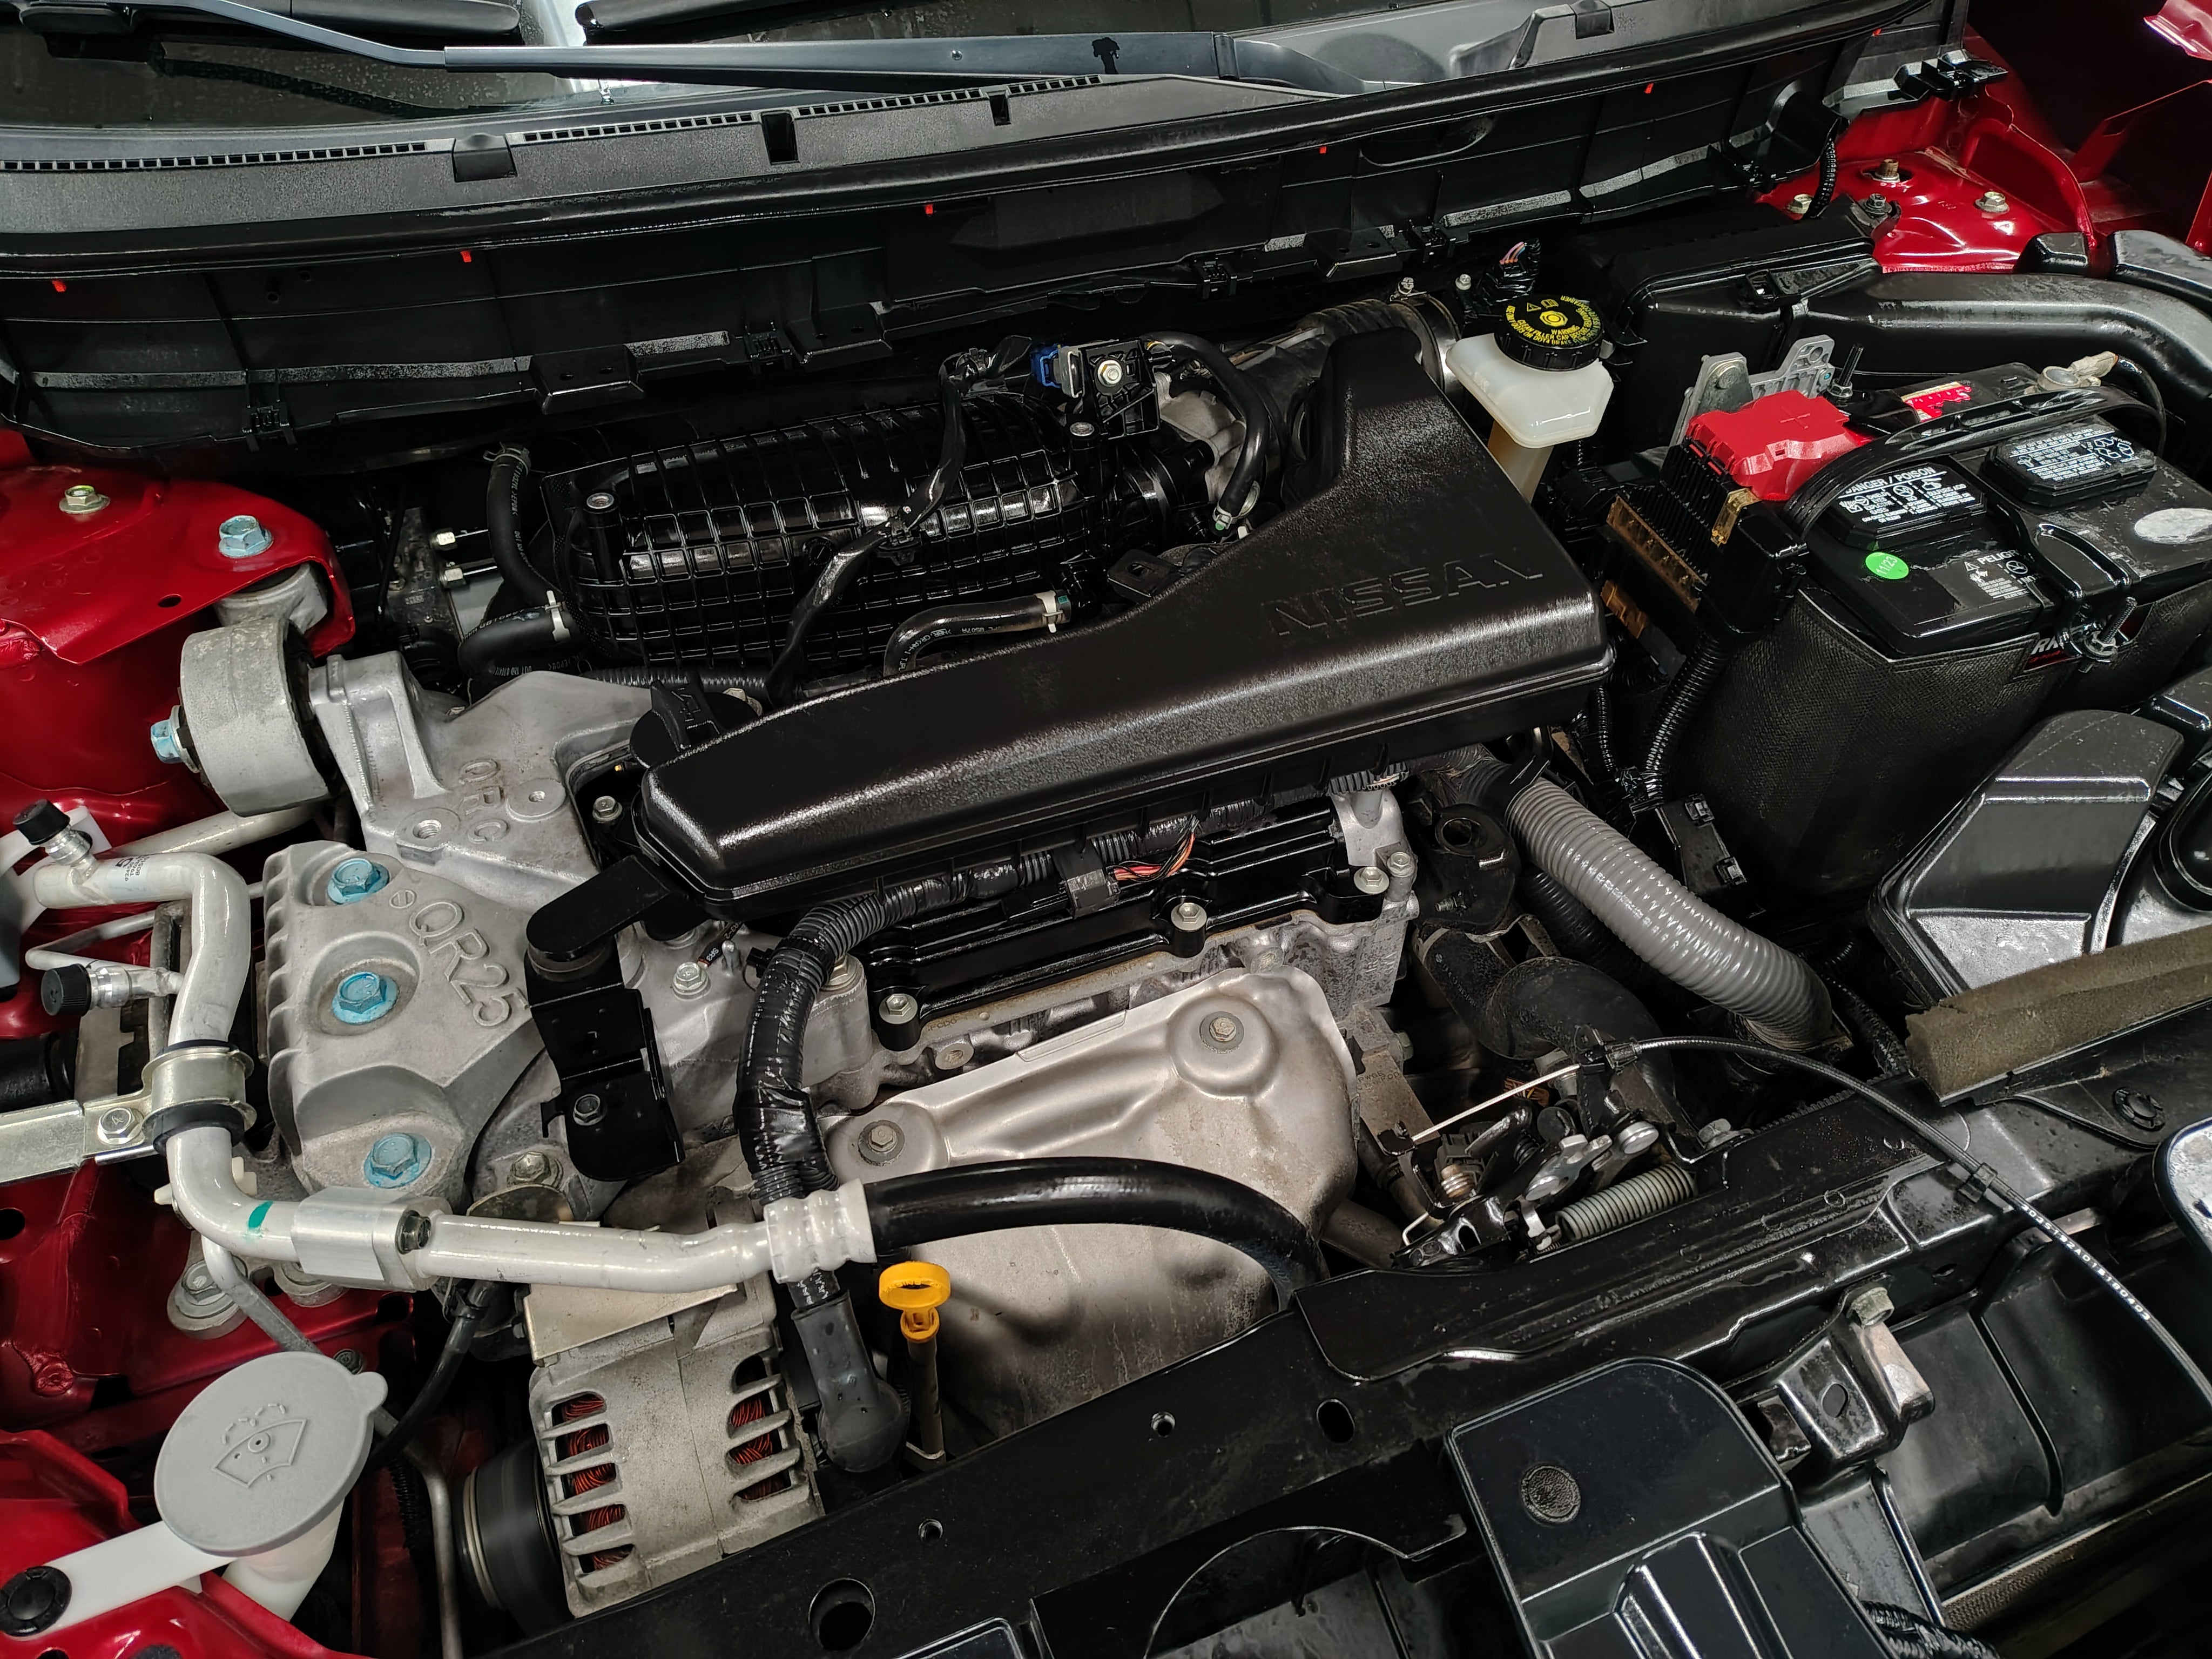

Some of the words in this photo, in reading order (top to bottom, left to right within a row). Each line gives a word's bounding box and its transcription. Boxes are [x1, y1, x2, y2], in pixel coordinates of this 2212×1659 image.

[1894, 466, 1937, 482] POISON
[1876, 556, 1898, 575] 11/23
[1977, 549, 2020, 565] PELIGR
[1260, 549, 1545, 637] NISSAN
[706, 947, 719, 961] SR3
[409, 900, 532, 1027] QR25
